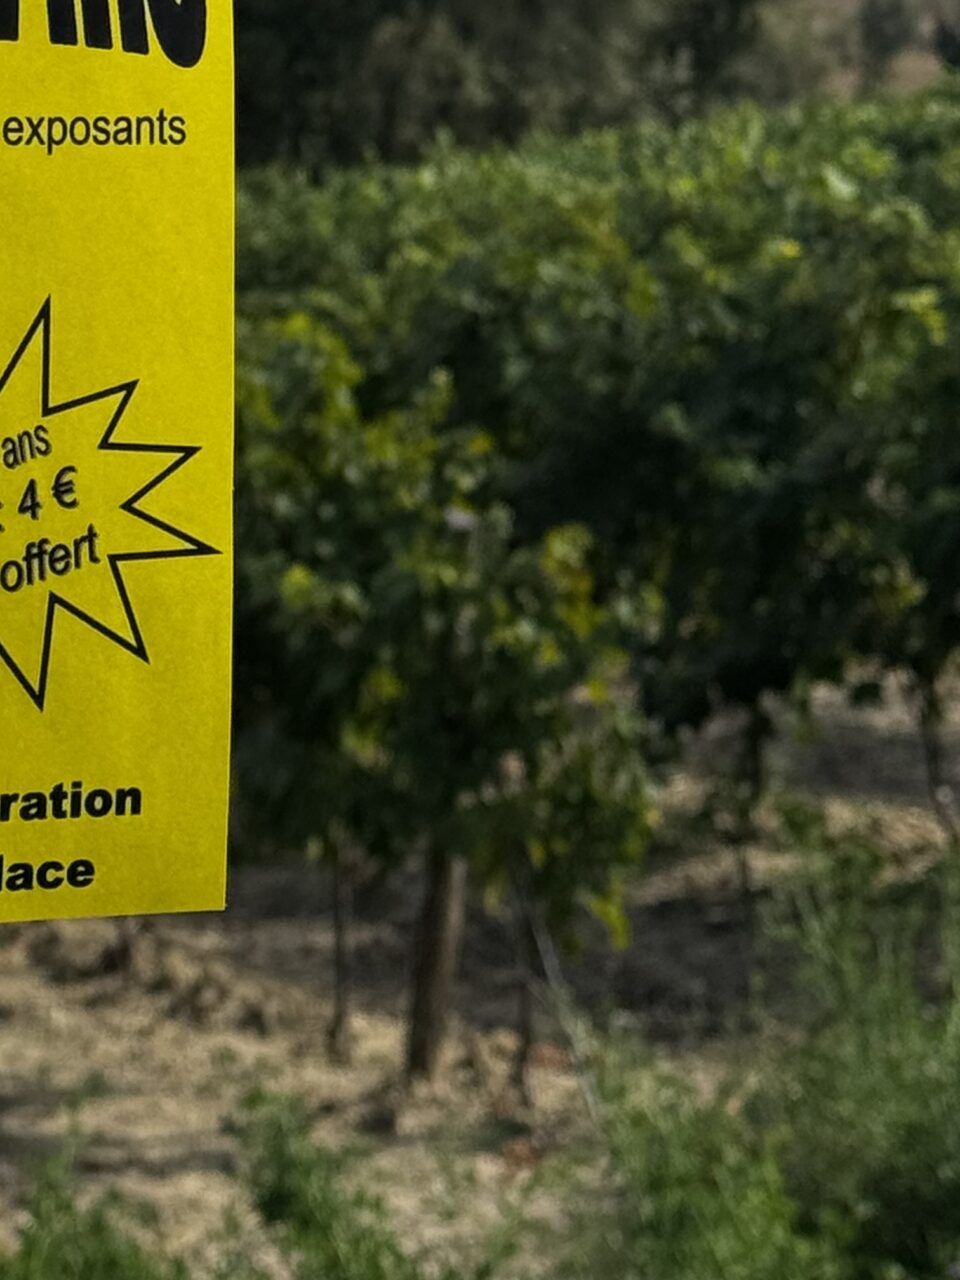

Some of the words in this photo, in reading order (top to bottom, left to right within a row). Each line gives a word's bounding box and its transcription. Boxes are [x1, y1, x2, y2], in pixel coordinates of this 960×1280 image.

[3, 109, 186, 154] exposants
[1, 425, 50, 469] ans
[18, 479, 41, 520] 4
[51, 466, 77, 509] €
